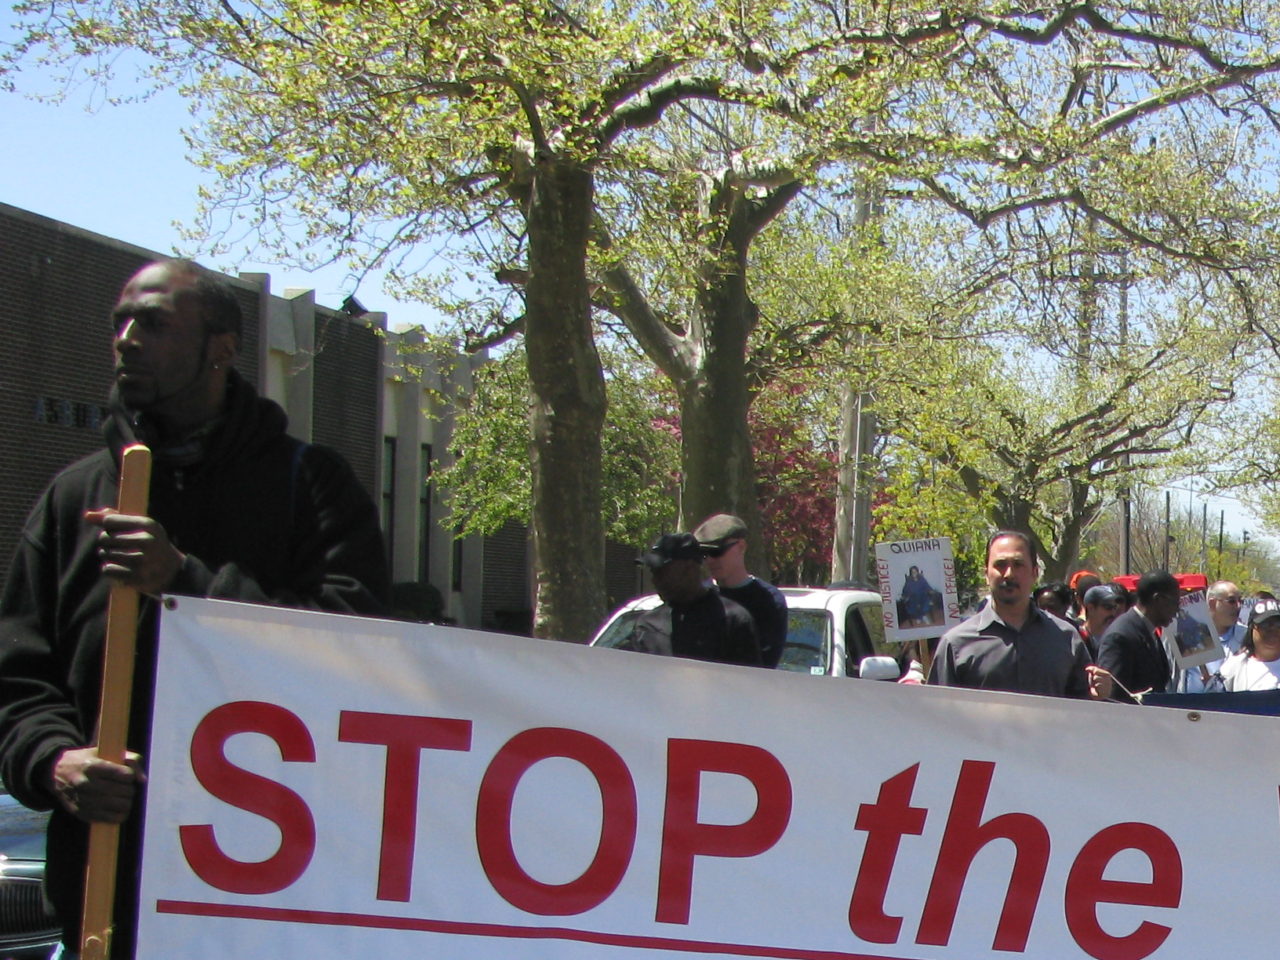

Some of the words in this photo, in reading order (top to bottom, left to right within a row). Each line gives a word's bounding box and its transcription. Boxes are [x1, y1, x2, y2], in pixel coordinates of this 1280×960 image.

[890, 540, 941, 554] QUIANA
[878, 558, 892, 604] JUSTICE!
[884, 611, 894, 628] NO
[948, 603, 960, 619] NO
[182, 701, 790, 924] STOP
